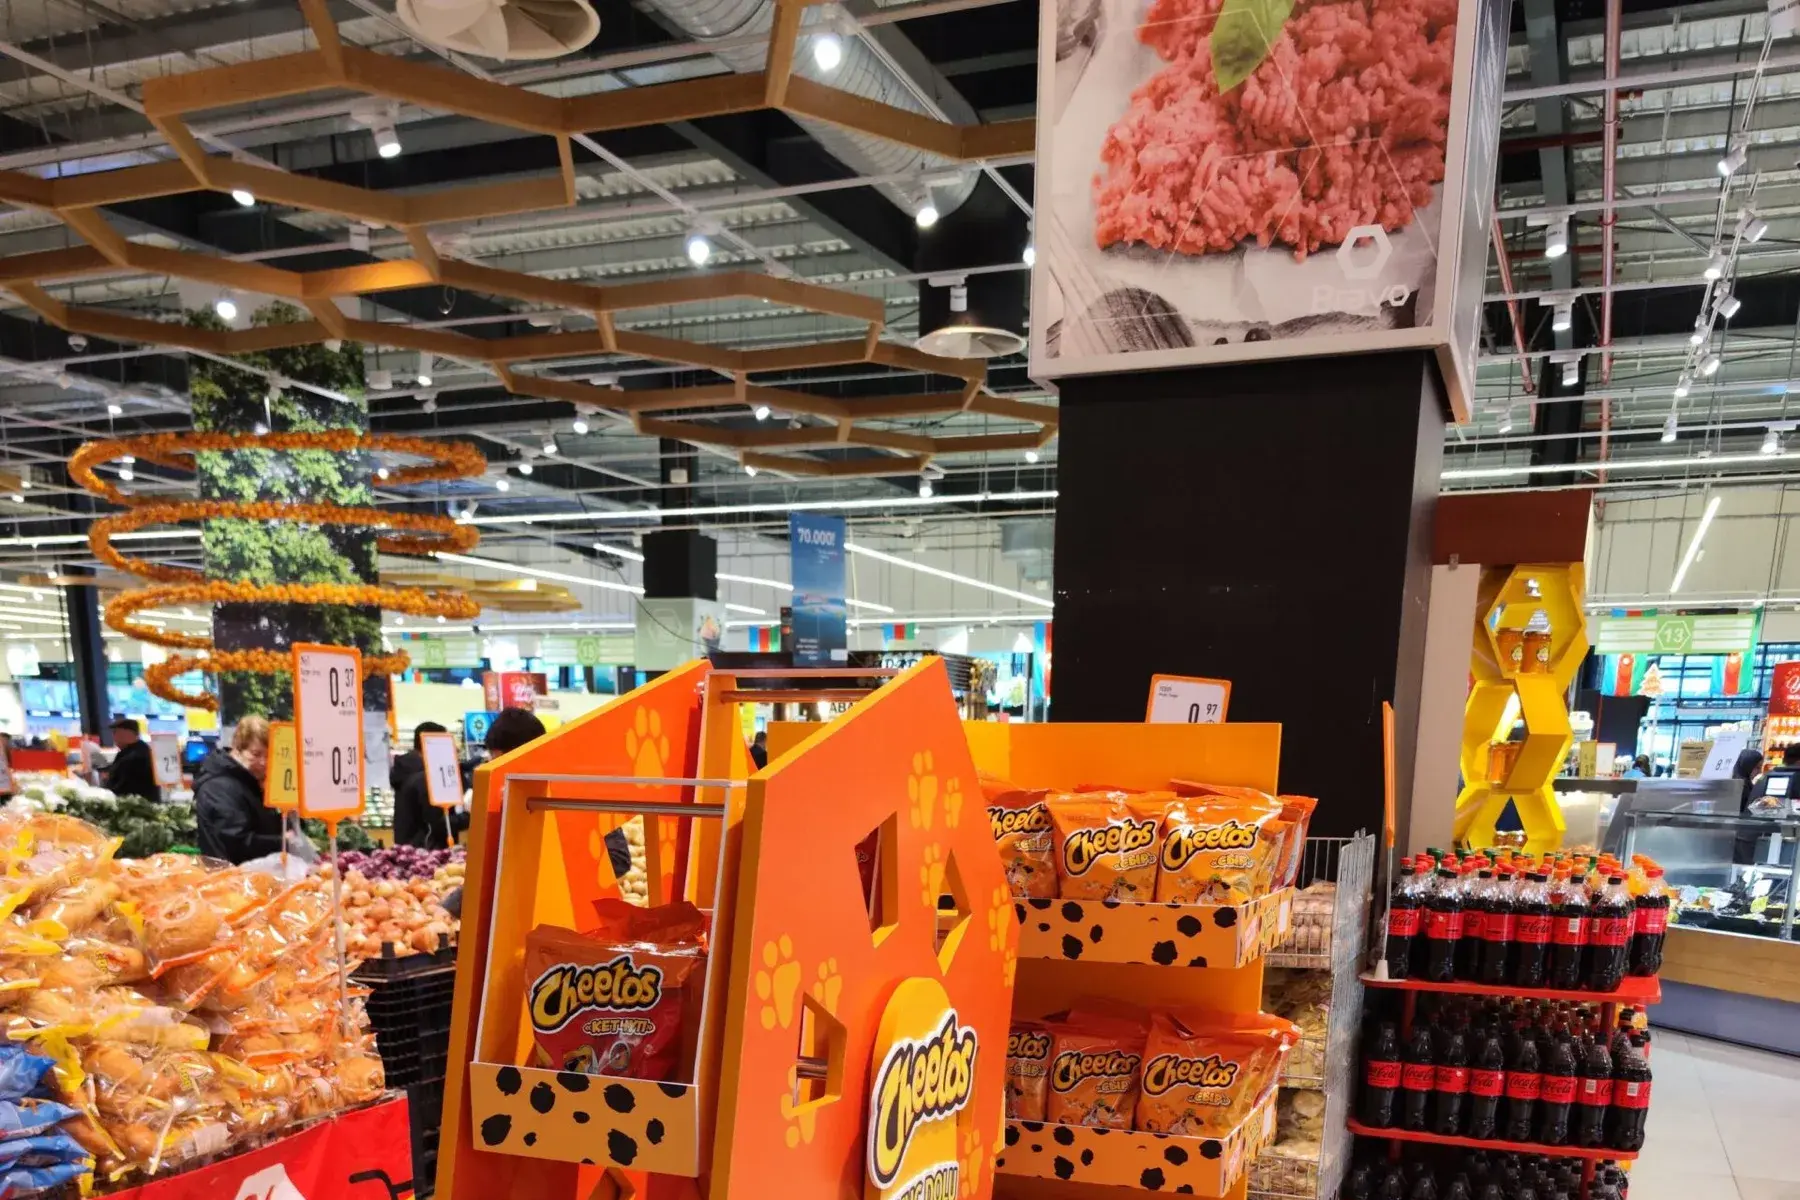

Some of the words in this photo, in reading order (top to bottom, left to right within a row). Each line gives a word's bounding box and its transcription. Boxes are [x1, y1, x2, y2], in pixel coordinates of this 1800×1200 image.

[1064, 820, 1156, 876] Cheetos
[1162, 821, 1259, 871] Cheetos
[531, 955, 662, 1032] Cheetos
[1007, 1031, 1050, 1060] etos
[1052, 1050, 1141, 1093] Cheetos
[1143, 1054, 1239, 1096] Cheetos
[872, 1011, 977, 1185] Cheetos
